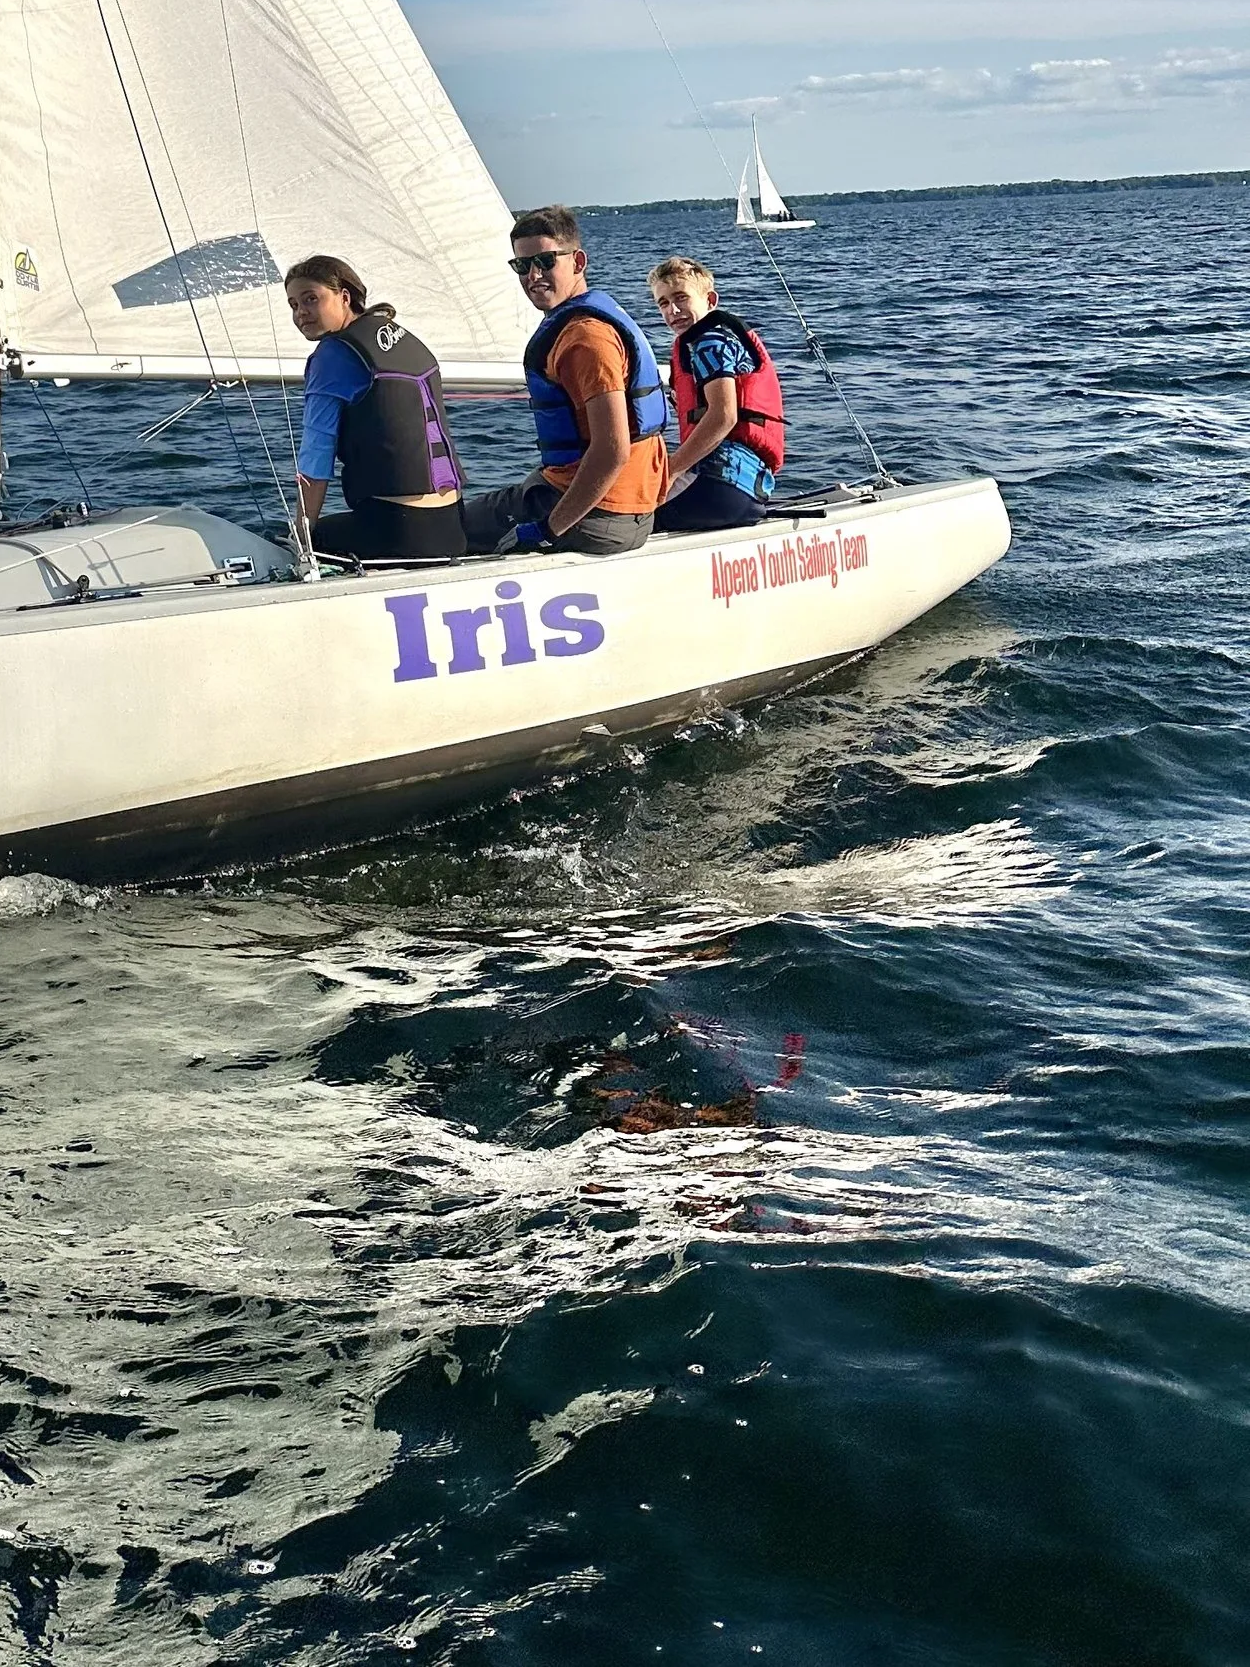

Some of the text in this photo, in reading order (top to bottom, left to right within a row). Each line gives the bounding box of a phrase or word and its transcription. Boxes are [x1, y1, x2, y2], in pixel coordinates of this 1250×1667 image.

[711, 529, 868, 608] Alpena Youth Sailing Team
[384, 580, 606, 683] Iris
